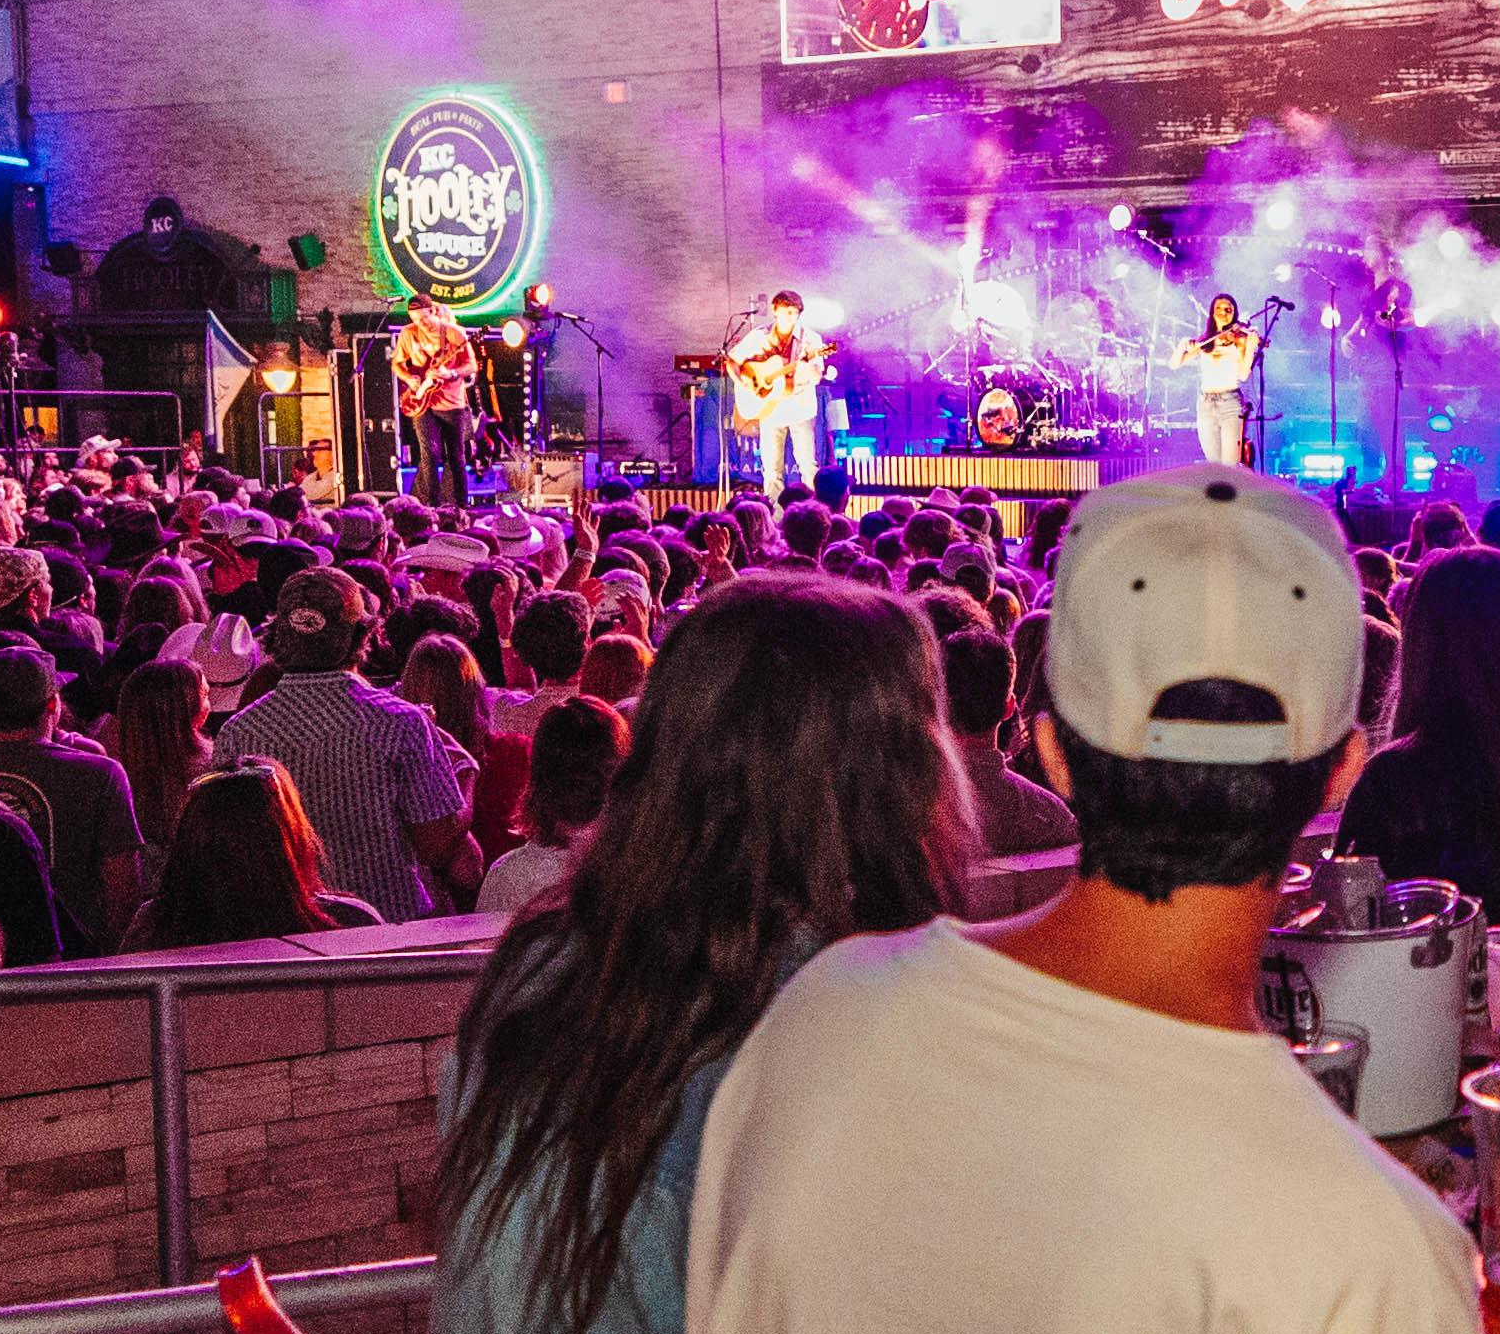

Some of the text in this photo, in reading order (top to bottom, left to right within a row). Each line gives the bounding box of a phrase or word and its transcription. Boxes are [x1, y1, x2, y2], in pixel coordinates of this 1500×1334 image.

[418, 143, 456, 173] KC
[385, 163, 516, 243] HOOLEY
[151, 216, 173, 234] KC
[430, 283, 451, 297] EST.
